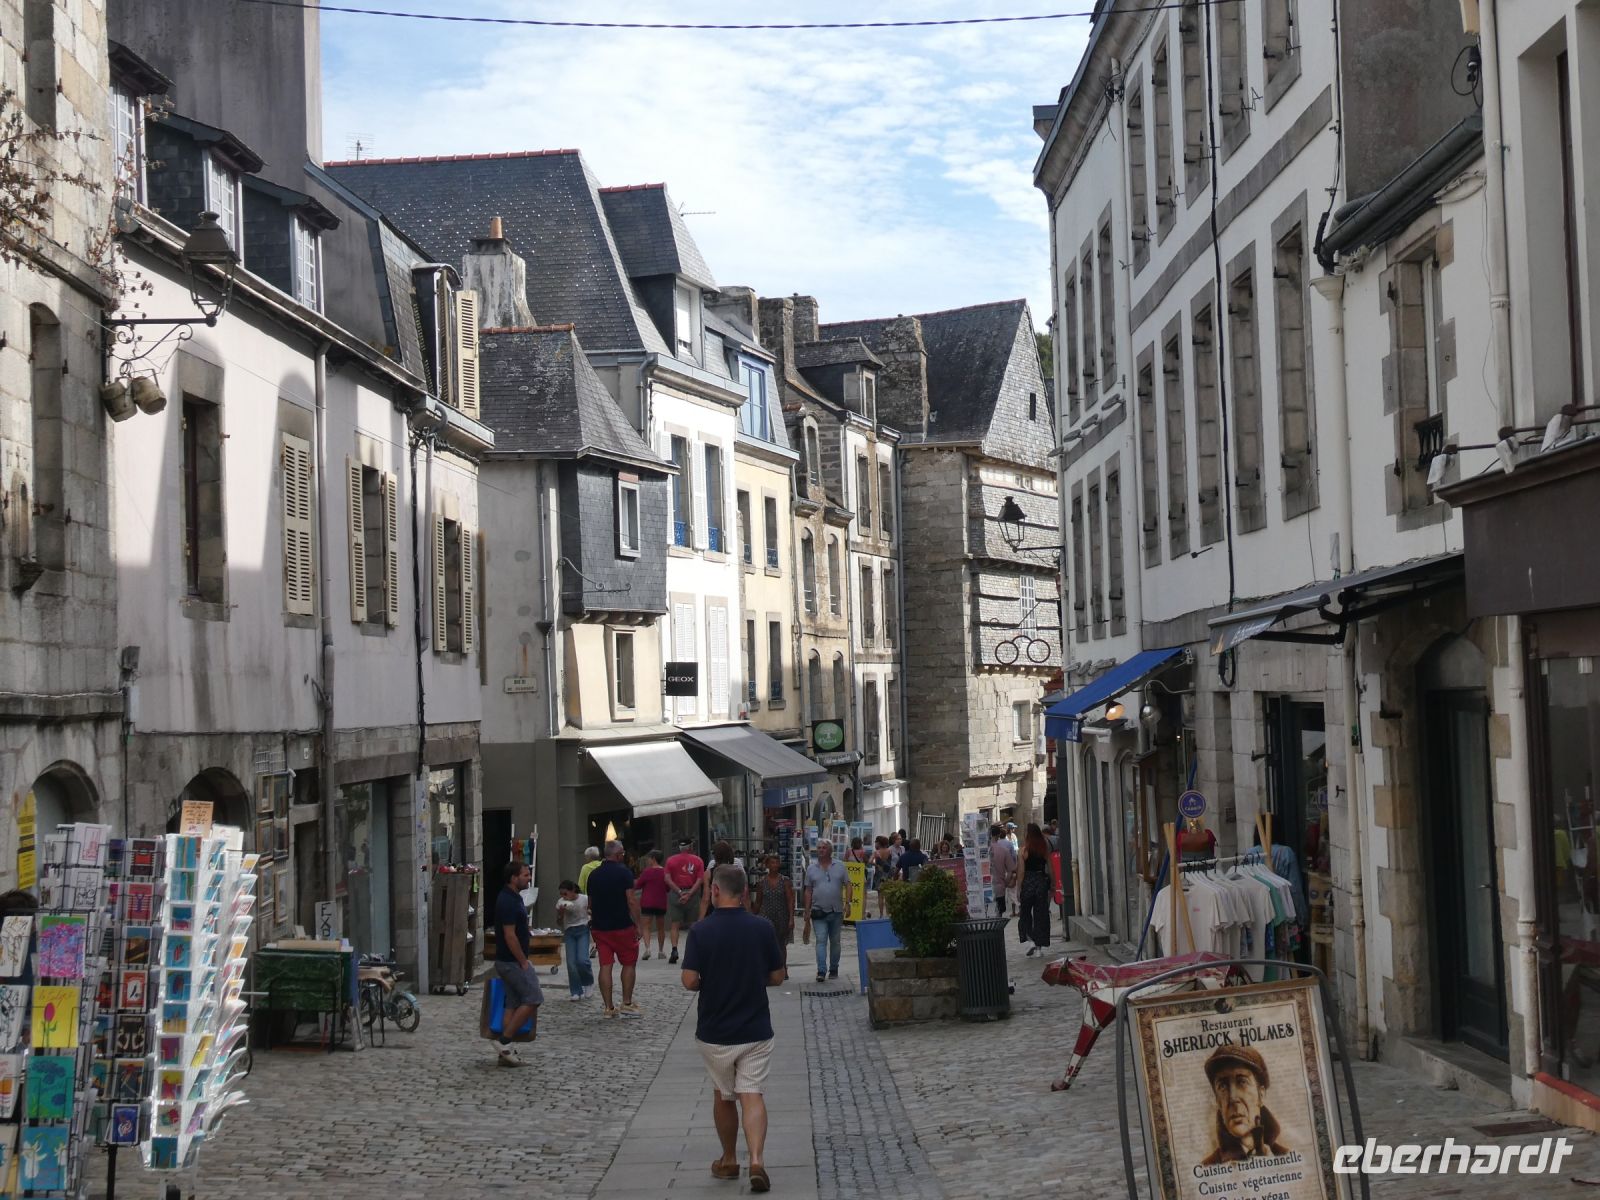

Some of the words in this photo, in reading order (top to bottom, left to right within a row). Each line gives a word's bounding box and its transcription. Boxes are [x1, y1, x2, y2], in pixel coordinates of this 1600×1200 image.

[1201, 1016, 1253, 1032] Restaurant
[1163, 1031, 1233, 1058] SHERLOCK
[1239, 1023, 1295, 1047] HOLMES
[1193, 1164, 1233, 1179] Cuisine
[1238, 1151, 1302, 1172] traditionnelle
[1198, 1182, 1238, 1196] Cuisine
[1243, 1171, 1302, 1192] végétarienne
